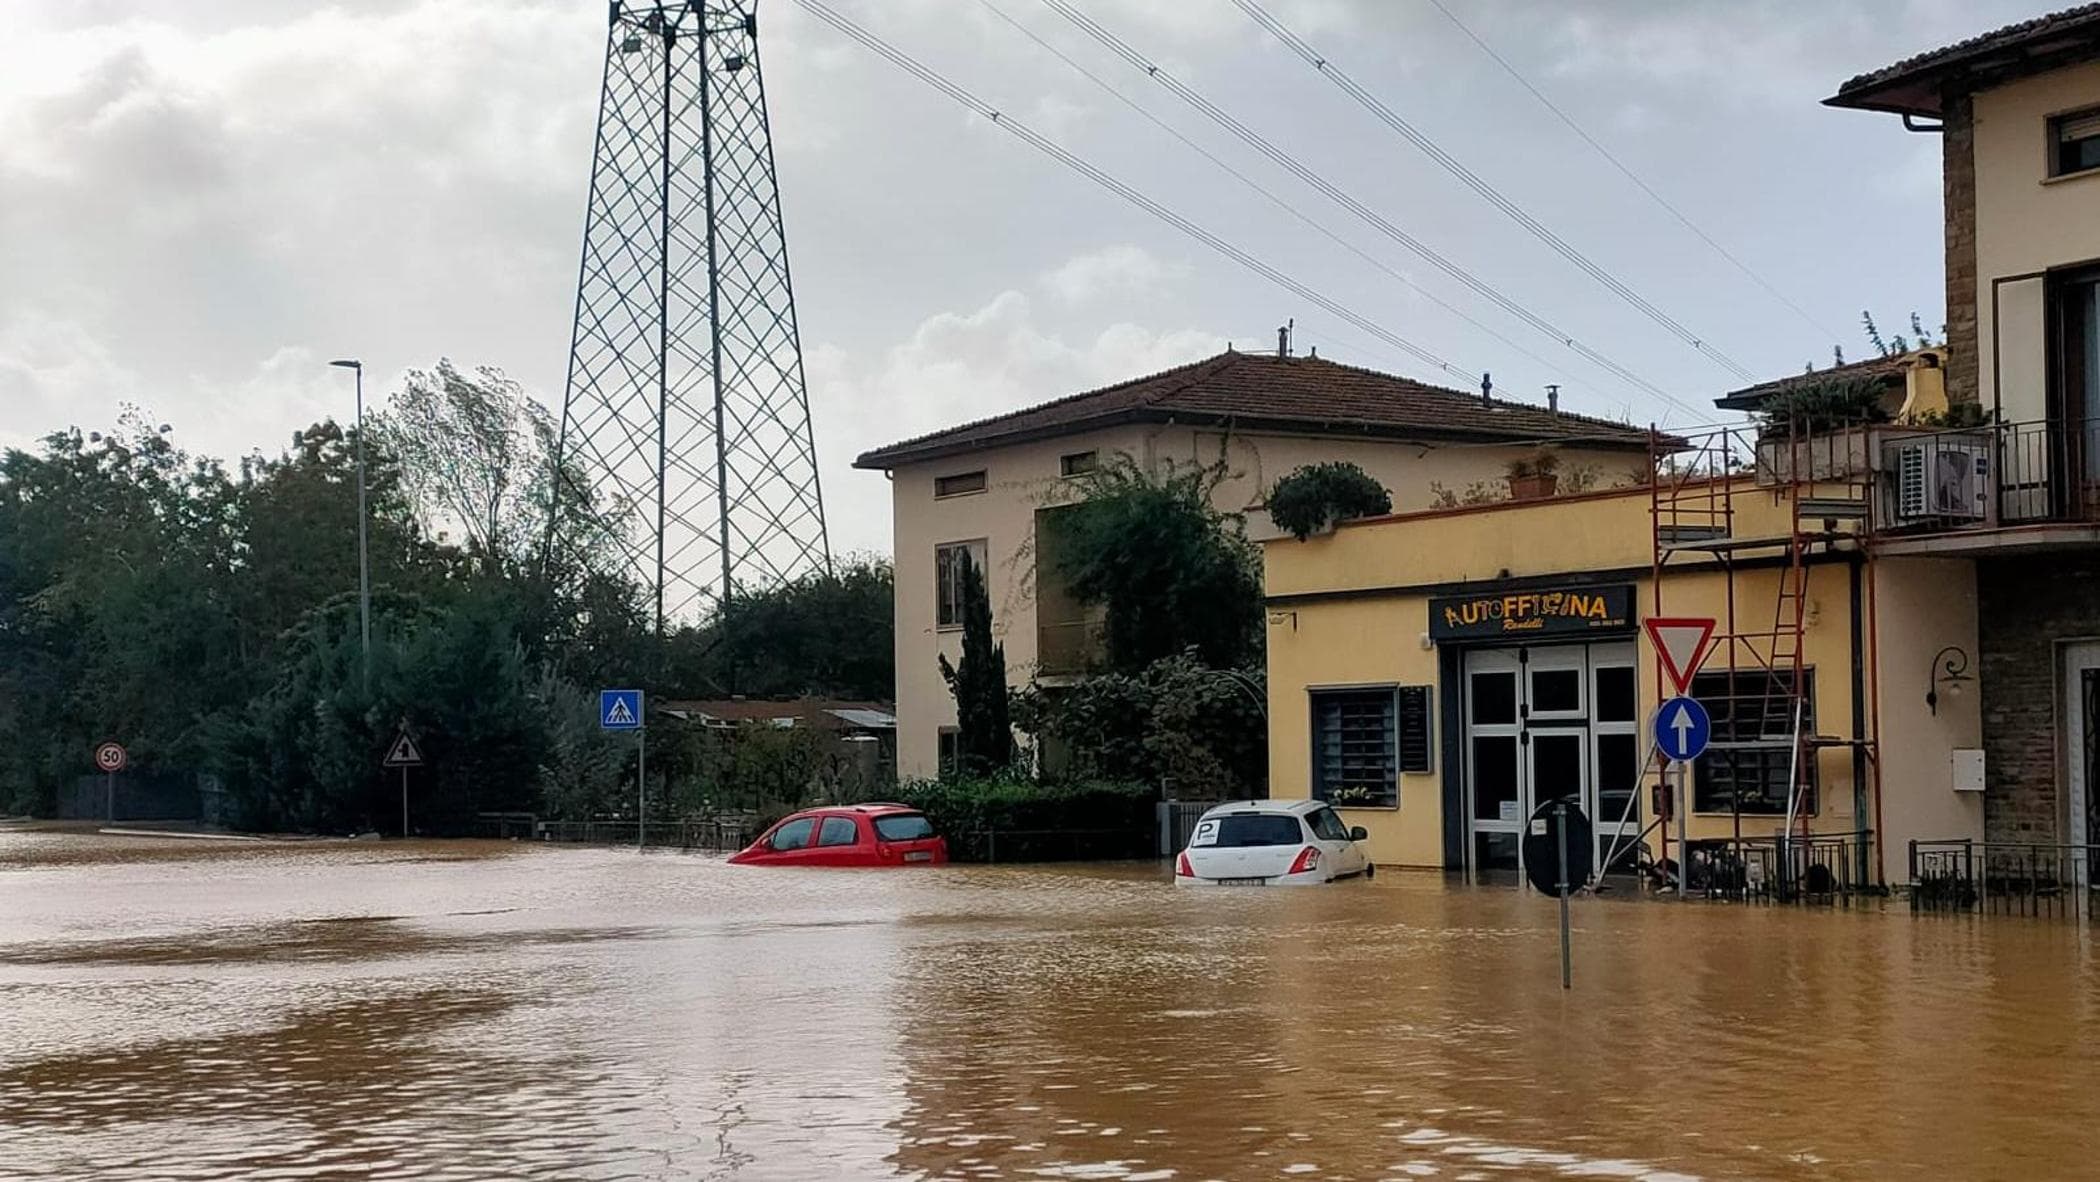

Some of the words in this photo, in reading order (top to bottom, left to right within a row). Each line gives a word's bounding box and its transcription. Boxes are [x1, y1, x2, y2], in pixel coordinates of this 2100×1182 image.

[1445, 592, 1608, 628] AUTOFFICINA
[104, 750, 119, 763] 50
[1197, 823, 1213, 840] P
